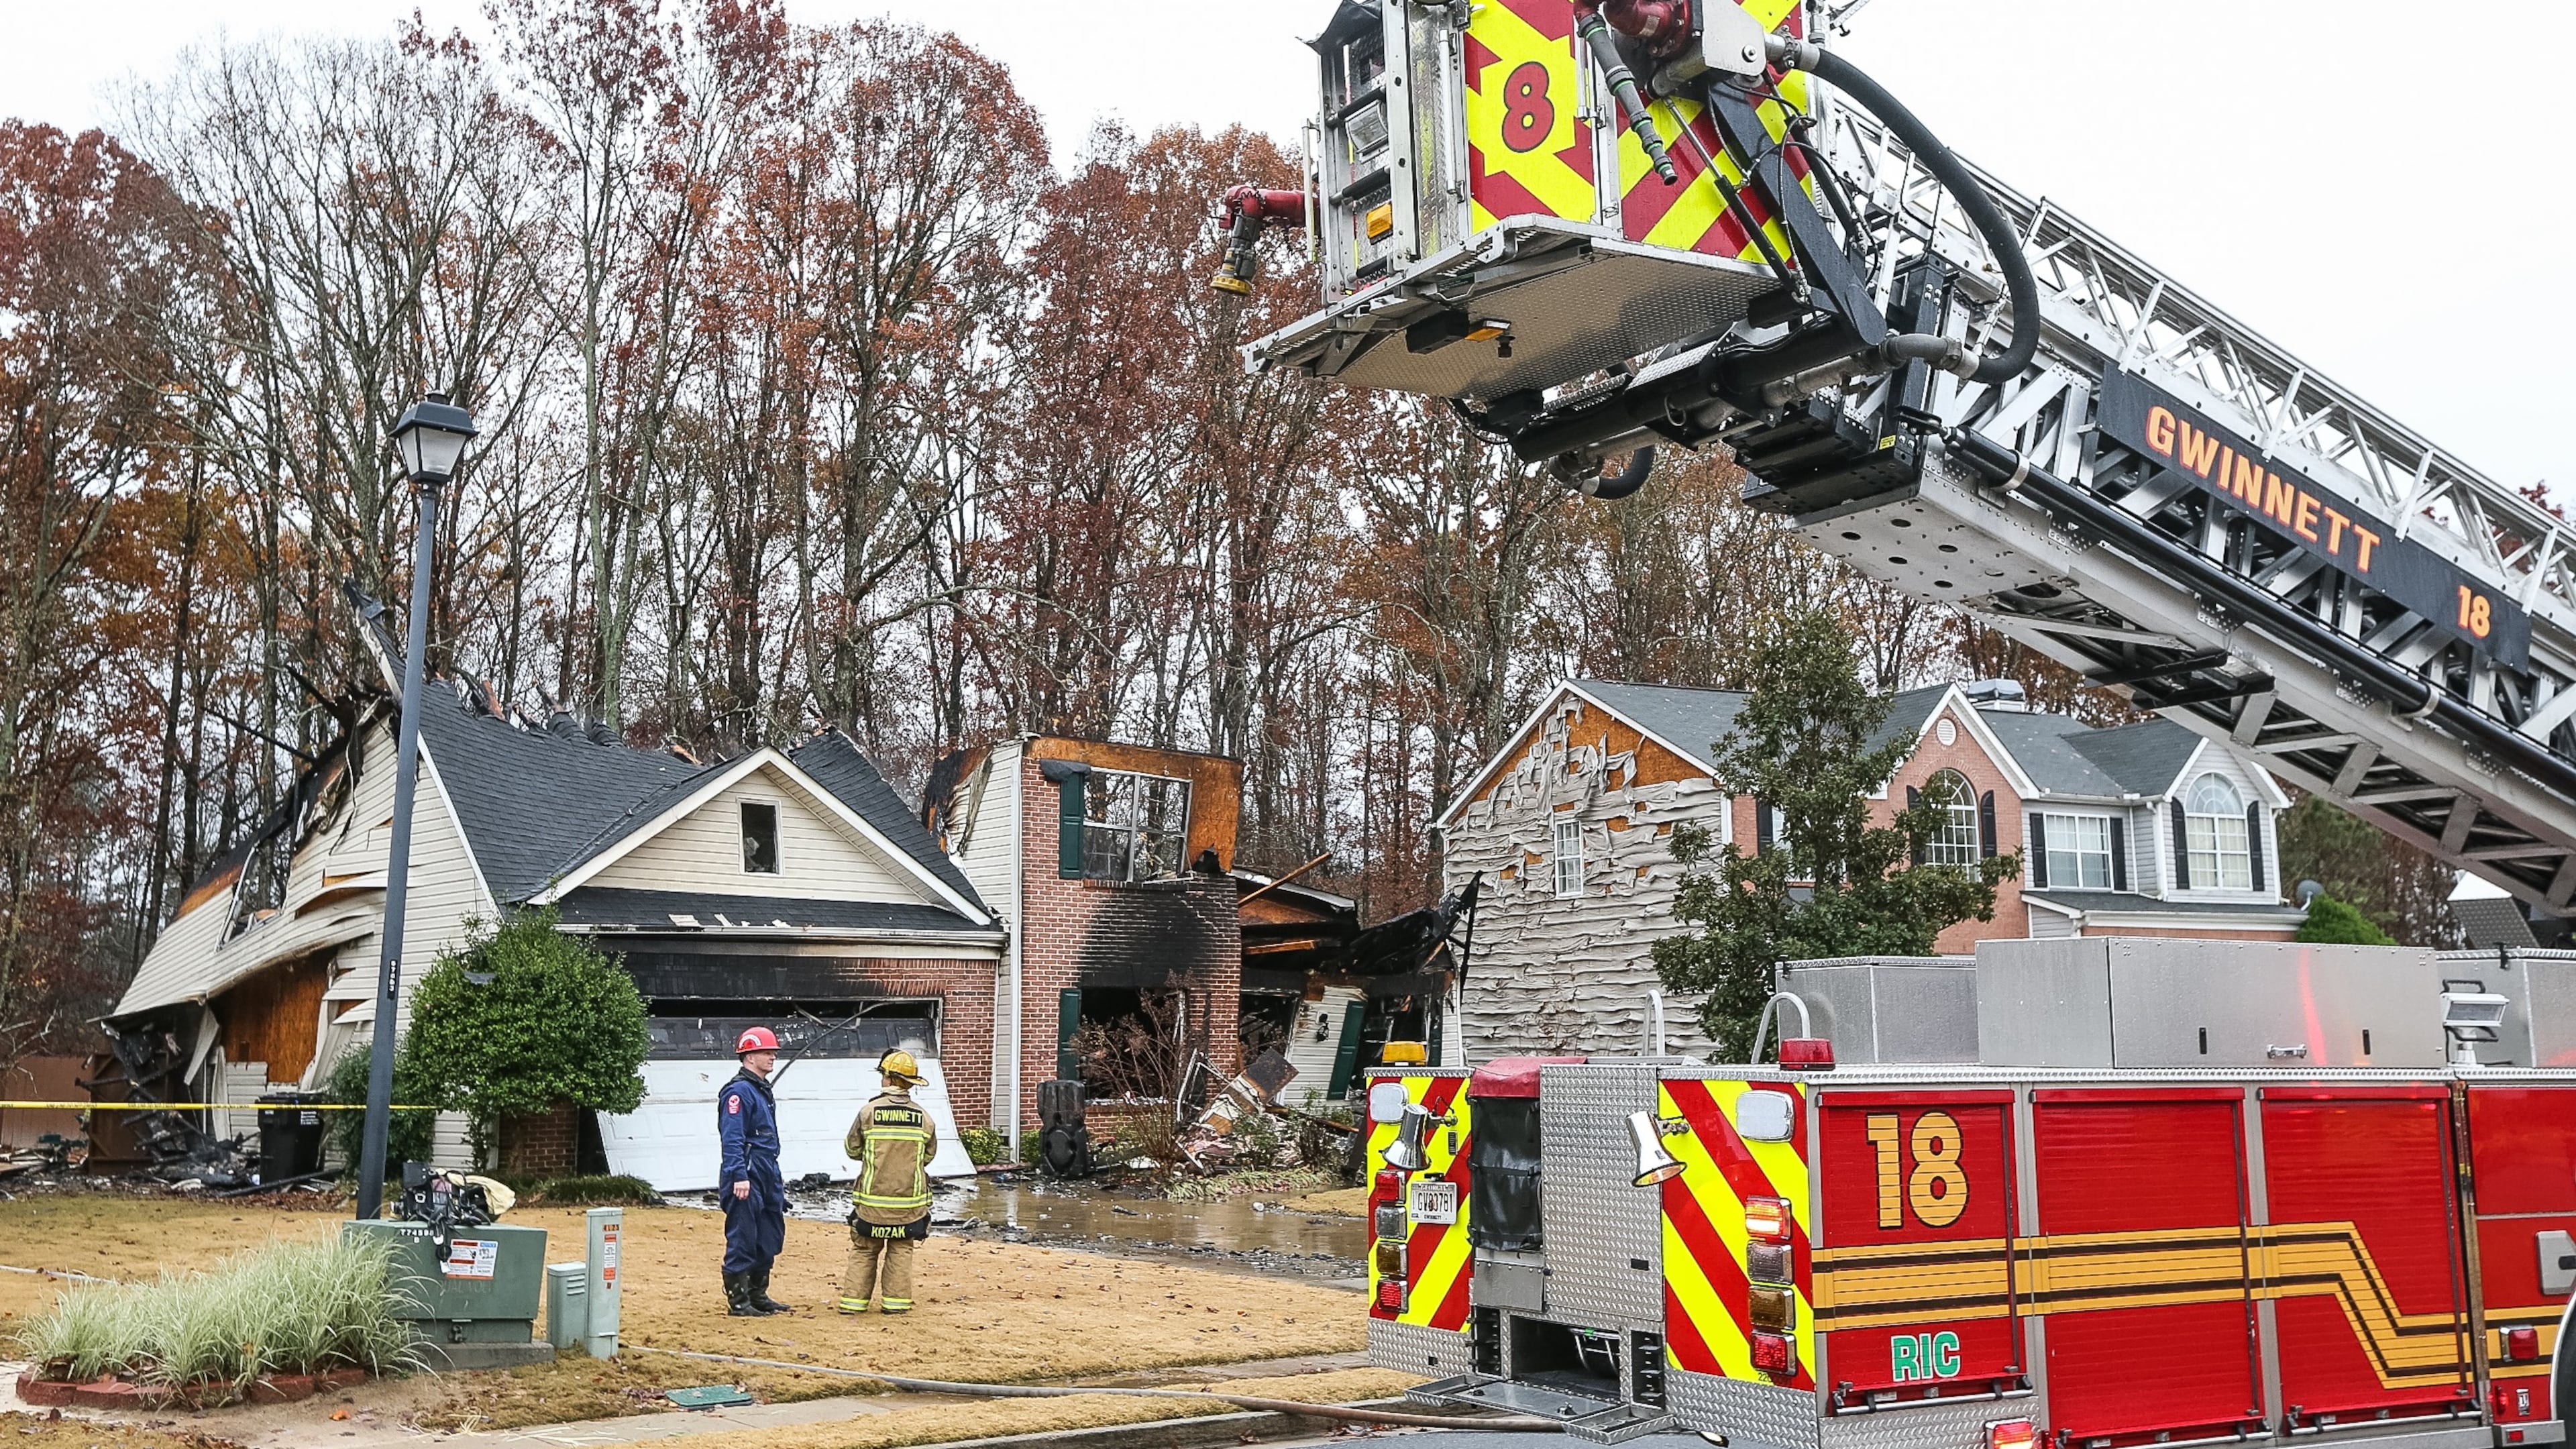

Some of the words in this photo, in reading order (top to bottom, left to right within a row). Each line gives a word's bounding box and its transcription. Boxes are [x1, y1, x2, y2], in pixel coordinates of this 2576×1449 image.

[1502, 61, 1554, 153] 8
[2146, 405, 2381, 574] GWINNETT
[2458, 584, 2491, 639] 18
[874, 1109, 923, 1124] GWINNETT
[1866, 1109, 1970, 1230] 18
[871, 1226, 906, 1238] KOZAK
[1890, 1331, 1961, 1382] RIC
